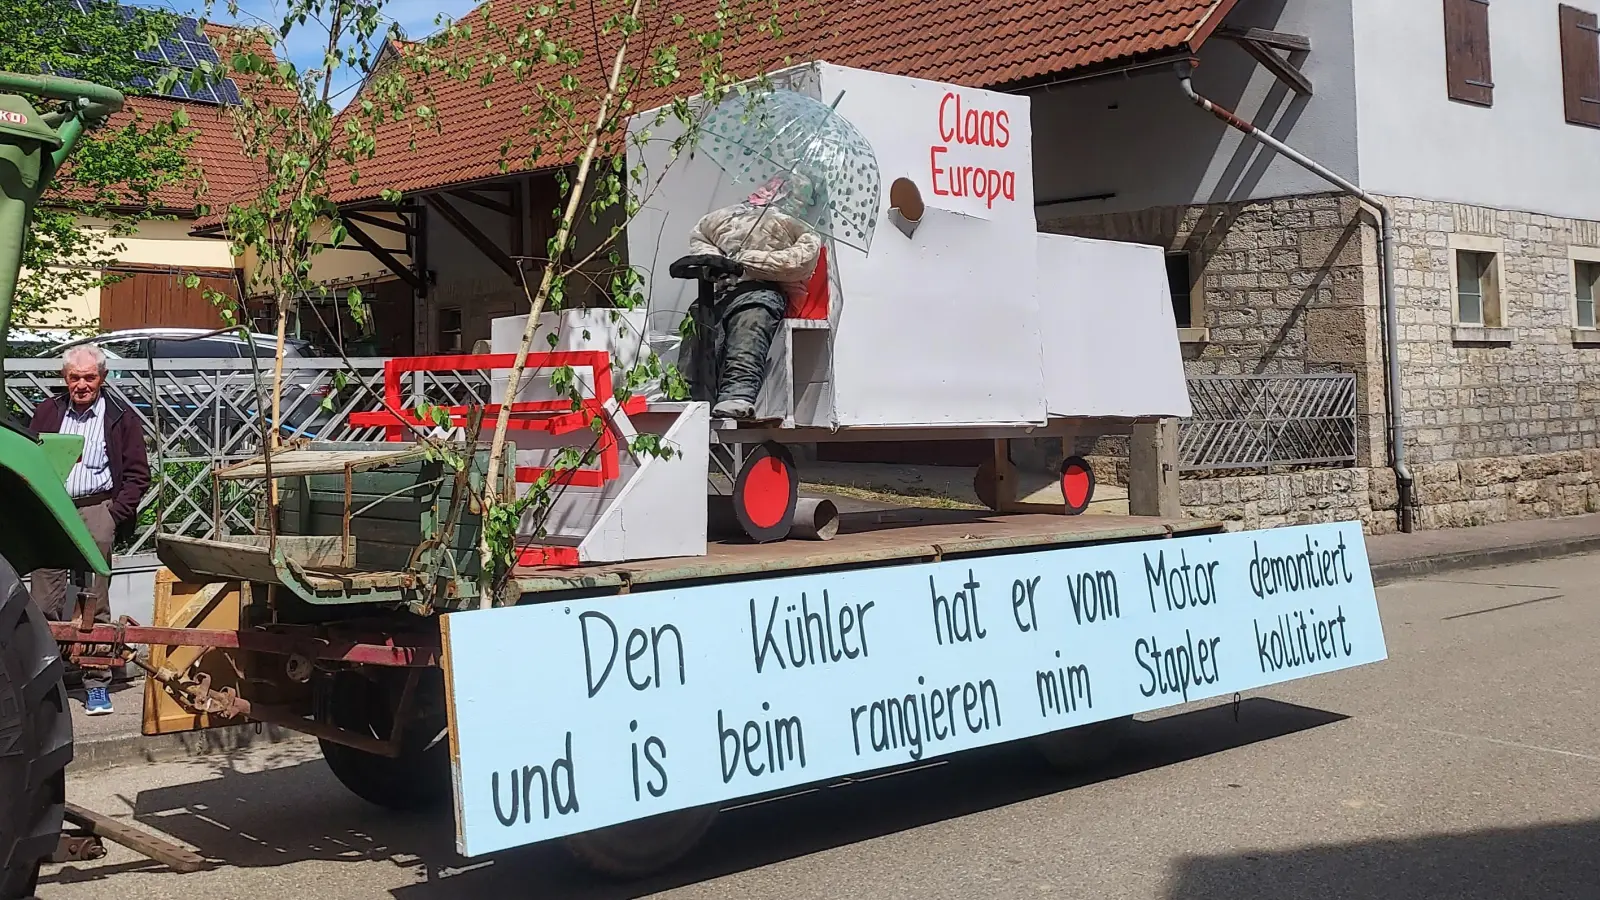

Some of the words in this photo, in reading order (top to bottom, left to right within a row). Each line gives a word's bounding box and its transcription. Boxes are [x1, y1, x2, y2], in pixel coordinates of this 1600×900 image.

[931, 145, 1015, 209] Europa
[938, 92, 1009, 148] Claas
[579, 610, 686, 699] Den
[750, 589, 875, 674] Kühler
[929, 568, 987, 646] hat
[1012, 576, 1041, 633] er
[1067, 570, 1120, 625] vom
[1143, 548, 1220, 613] Motor
[1250, 531, 1353, 600] demontiert
[492, 731, 580, 827] und
[630, 720, 668, 802] is
[718, 702, 806, 784] beim
[851, 676, 1002, 761] rangieren
[1036, 651, 1093, 718] mim
[1135, 629, 1221, 703] Stapler
[1254, 605, 1353, 674] kollitiert
